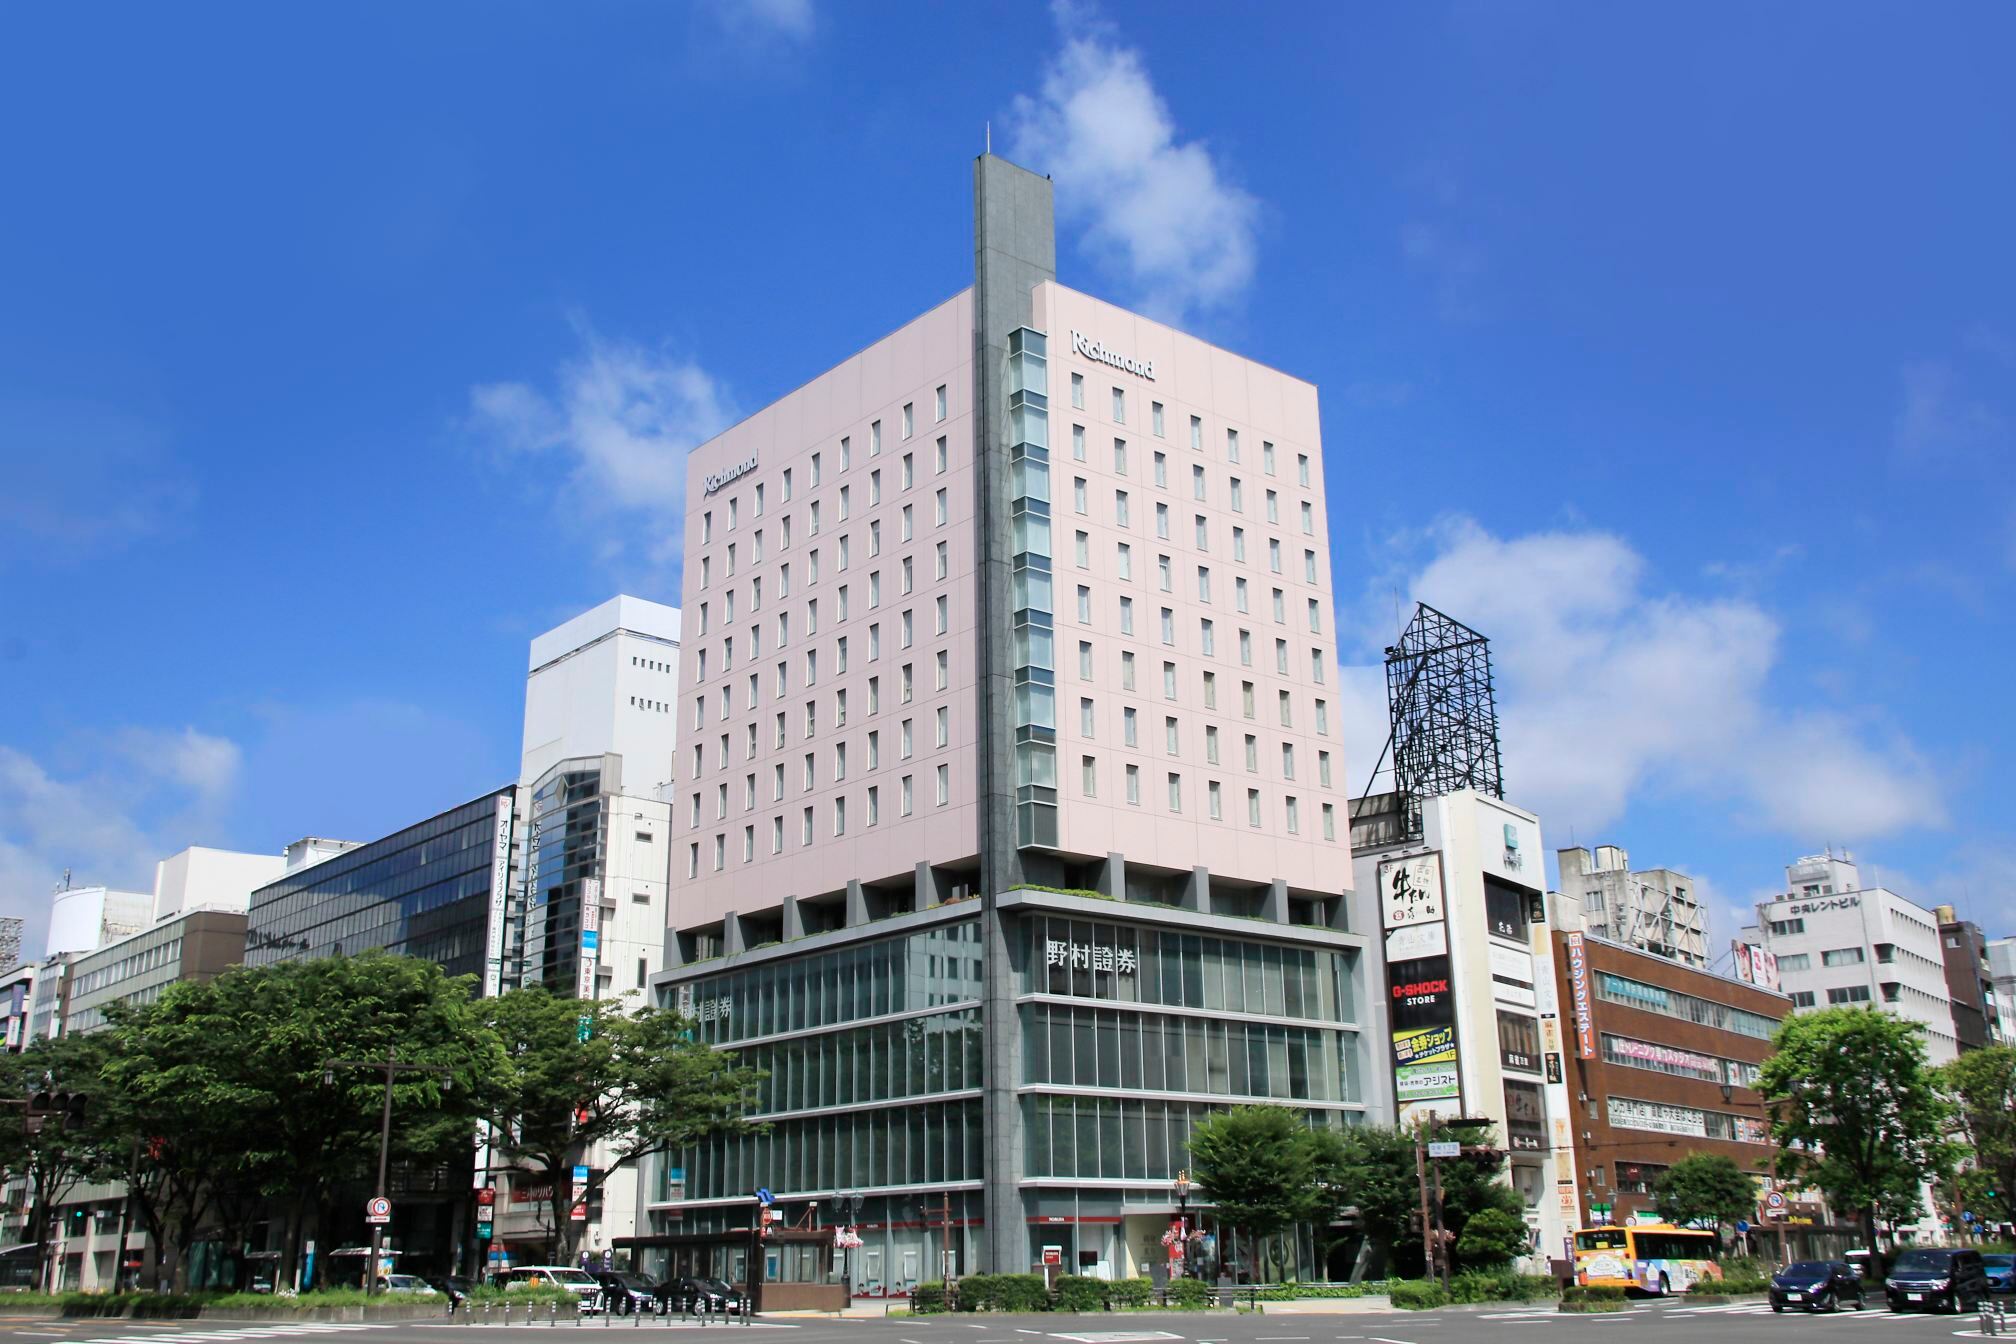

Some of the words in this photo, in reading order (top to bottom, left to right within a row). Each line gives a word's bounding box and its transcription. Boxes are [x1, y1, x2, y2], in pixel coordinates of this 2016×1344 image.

[1071, 328, 1156, 382] Richmond
[704, 448, 758, 497] Richmond
[499, 820, 508, 851] オーヤマ
[1392, 866, 1431, 904] 牛たん
[1790, 897, 1861, 915] 中央レントビル
[1047, 940, 1137, 974] 野村證券
[1393, 979, 1448, 997] G-SHOCK
[1406, 994, 1436, 1006] STORE
[1570, 947, 1593, 1056] ハウジングエステート
[1410, 1026, 1453, 1053] 金券ショップ
[1446, 1050, 1456, 1060] 1F
